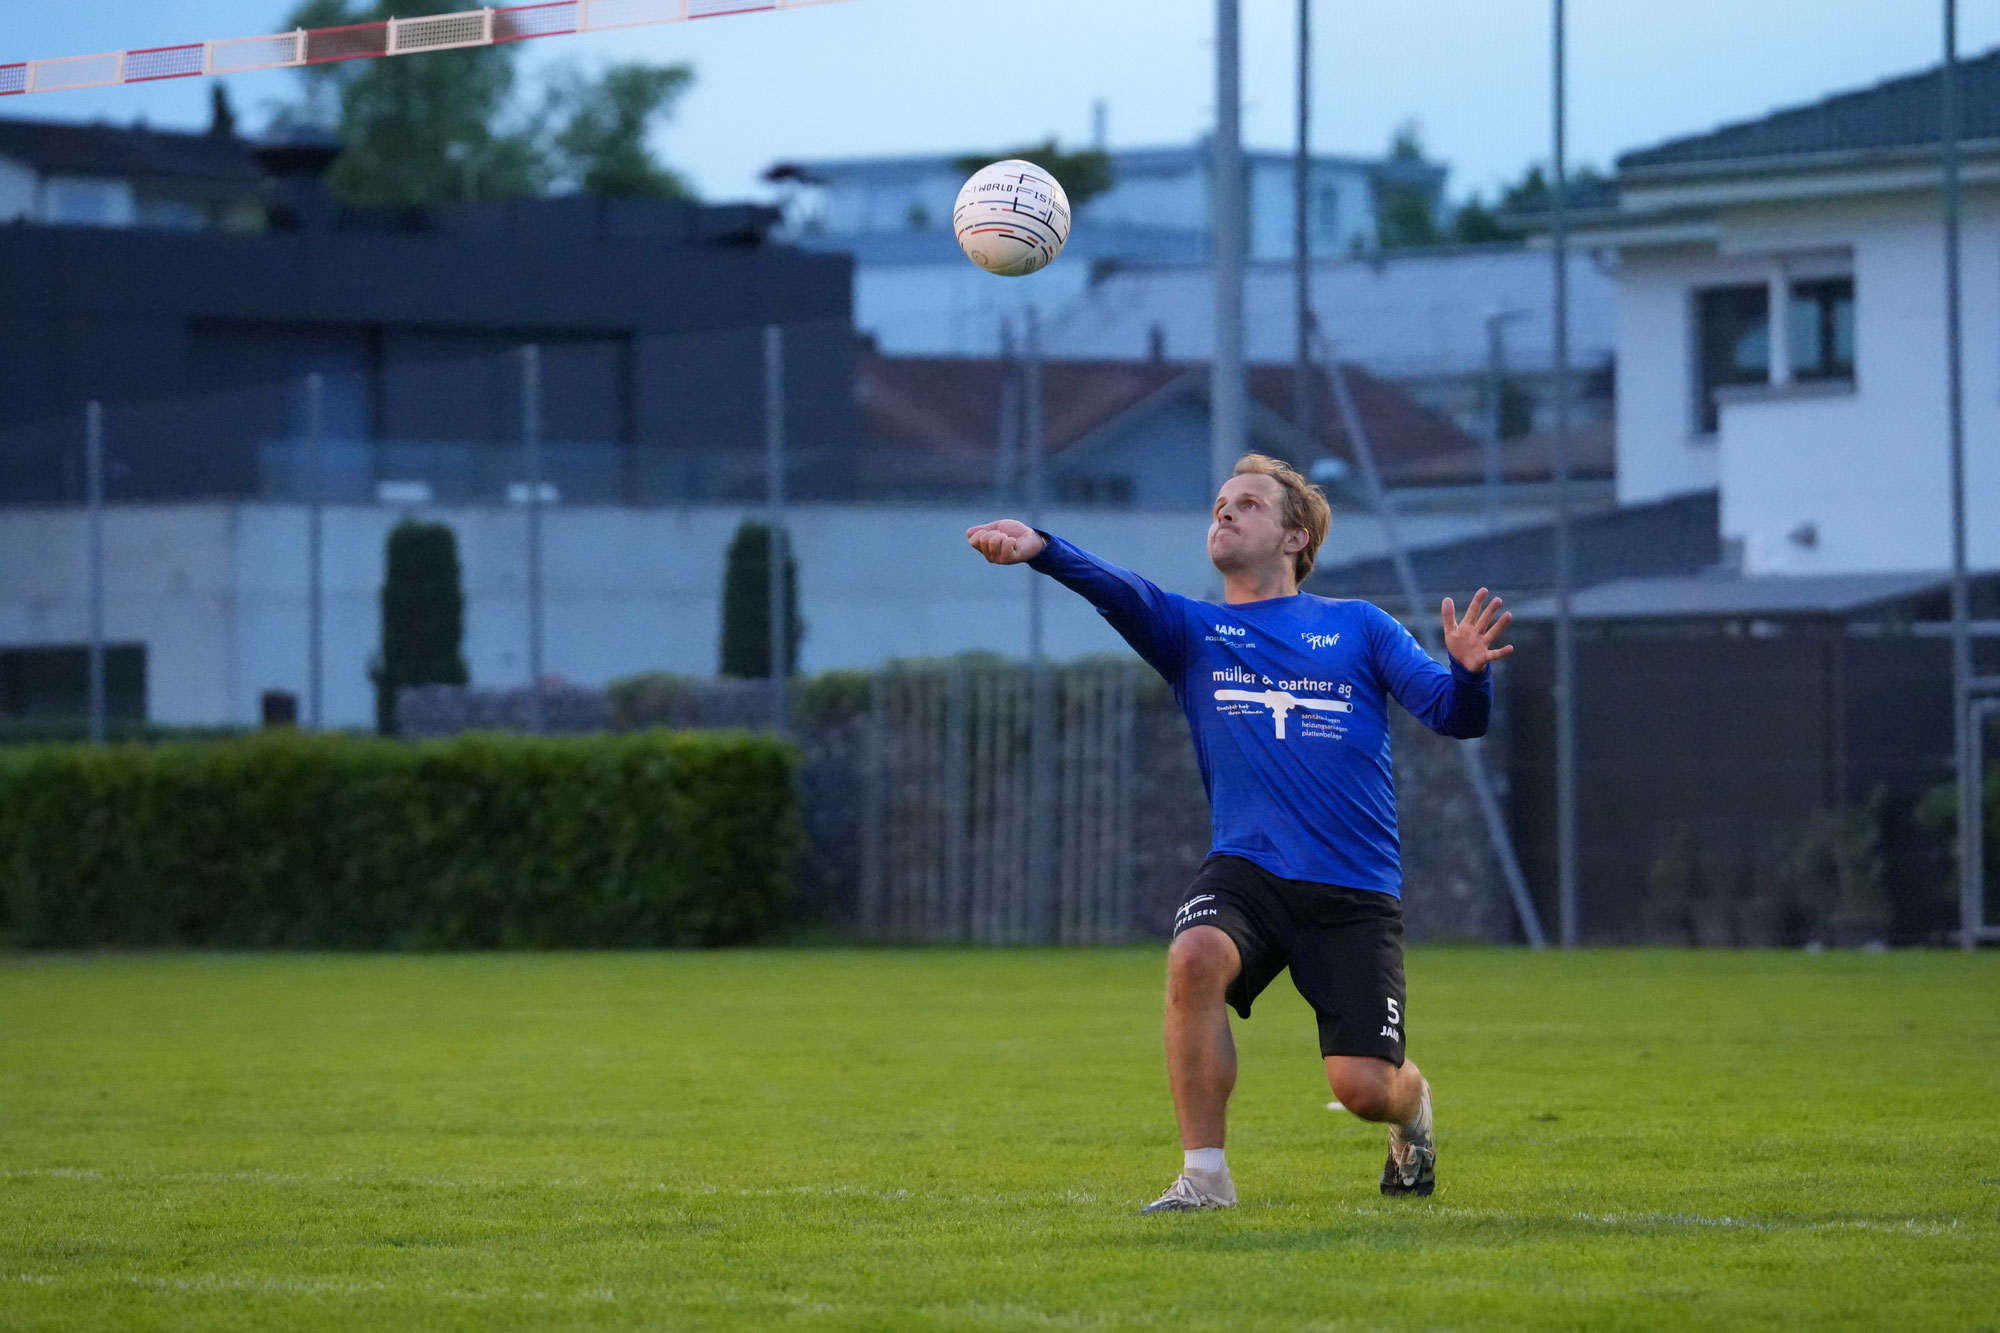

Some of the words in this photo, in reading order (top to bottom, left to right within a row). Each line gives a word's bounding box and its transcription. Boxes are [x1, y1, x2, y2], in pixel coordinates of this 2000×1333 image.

[979, 183, 1013, 192] WORLD
[1212, 665, 1256, 684] müller
[1278, 677, 1333, 692] partner
[1338, 683, 1352, 698] ag
[1386, 997, 1400, 1025] 5
